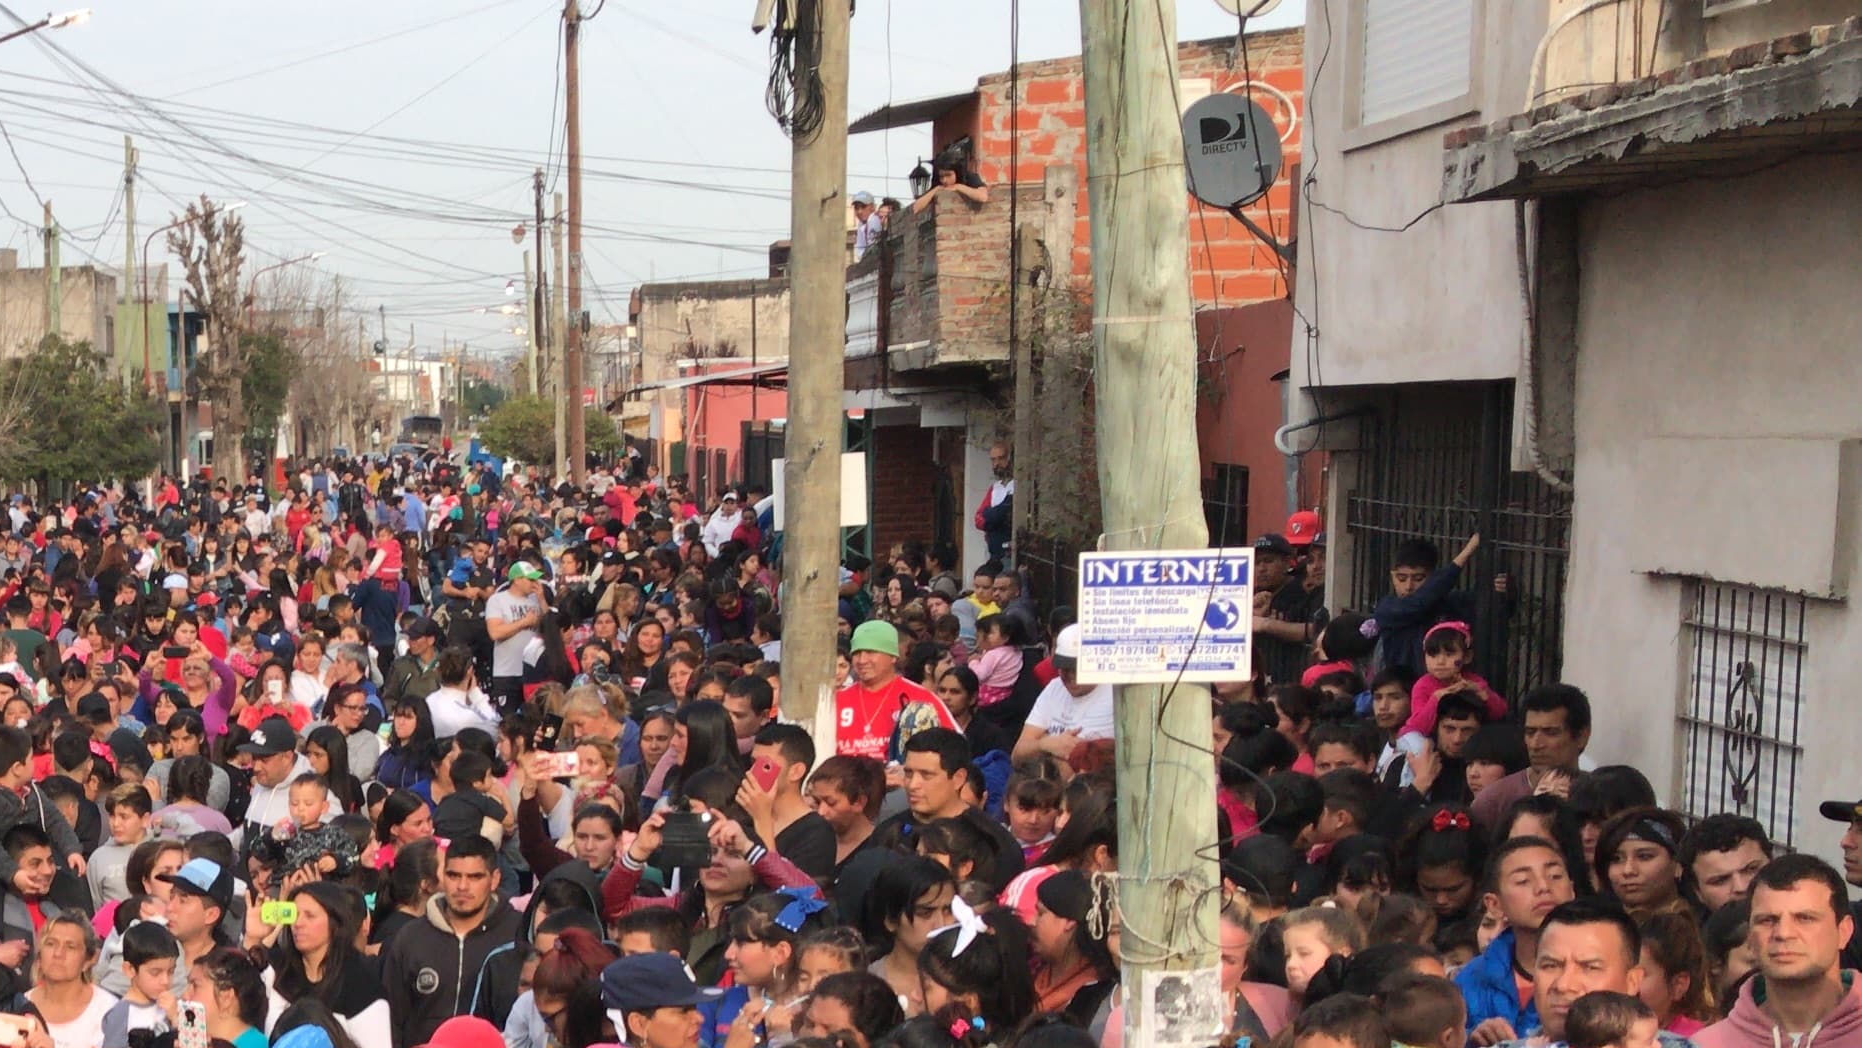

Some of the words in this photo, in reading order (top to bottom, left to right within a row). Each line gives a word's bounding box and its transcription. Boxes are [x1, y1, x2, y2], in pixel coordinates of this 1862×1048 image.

[1201, 141, 1247, 156] DIRECTV
[1085, 559, 1247, 585] INTERNET
[840, 707, 854, 728] 9
